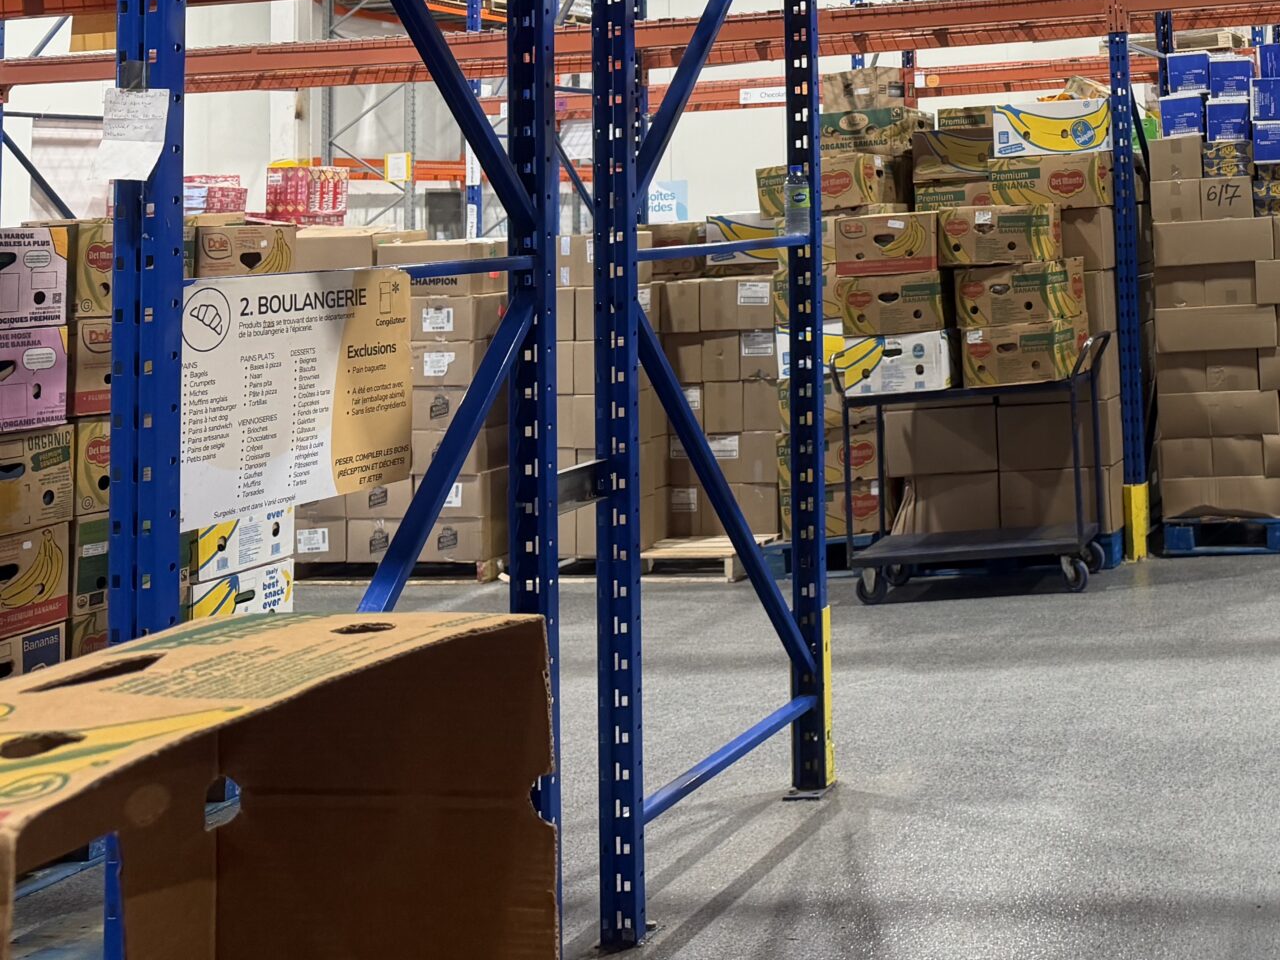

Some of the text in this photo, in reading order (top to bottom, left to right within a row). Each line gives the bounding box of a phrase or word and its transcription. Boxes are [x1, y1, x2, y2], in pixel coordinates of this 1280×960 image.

[940, 117, 976, 127] Premium
[820, 138, 888, 152] ORGANIC BANANAS
[991, 171, 1028, 181] Premium
[760, 176, 786, 187] Premi
[992, 180, 1036, 191] BNANAS
[648, 190, 676, 200] oîtes
[916, 193, 954, 204] Premium
[4, 232, 34, 240] MARQUE
[208, 238, 229, 250] Dole
[410, 277, 458, 286] CHAMPION
[240, 288, 367, 317] 2. BOULANGERIE
[238, 320, 262, 330] Produits
[263, 318, 275, 328] frais
[282, 316, 304, 325] trouvant
[306, 314, 318, 324] dans
[318, 314, 324, 322] le
[324, 312, 356, 323] département
[375, 317, 406, 328] Congélateur
[10, 340, 42, 348] BANANA
[290, 348, 316, 357] DESSERTS
[347, 342, 397, 359] Exclusions
[240, 352, 275, 362] PAINS PLATS
[352, 364, 386, 374] Pain baguette
[190, 370, 208, 379] Bagels
[190, 379, 216, 388] Crumpets
[188, 396, 228, 406] Muffins anglais
[248, 398, 268, 408] Tortillas
[298, 400, 320, 408] Cupcakes
[352, 400, 407, 416] Sans liste d'ingrédients
[238, 414, 278, 427] VIENNOISERIES
[247, 426, 268, 434] Brioches
[28, 430, 71, 451] ORGANIC
[246, 444, 264, 452] Crêpes
[355, 450, 383, 462] COMPILER
[384, 448, 394, 456] LES
[394, 444, 410, 454] BONS
[245, 452, 271, 462] Croissants
[371, 462, 378, 471] ET
[293, 470, 310, 478] Scones
[242, 480, 262, 489] Muffins
[292, 478, 308, 488] Tartes
[242, 488, 265, 498] Torsades
[266, 508, 284, 520] ever
[266, 568, 278, 577] likely
[262, 580, 280, 591] best
[264, 587, 284, 600] snack
[262, 598, 281, 610] ever
[24, 634, 58, 652] Bananas
